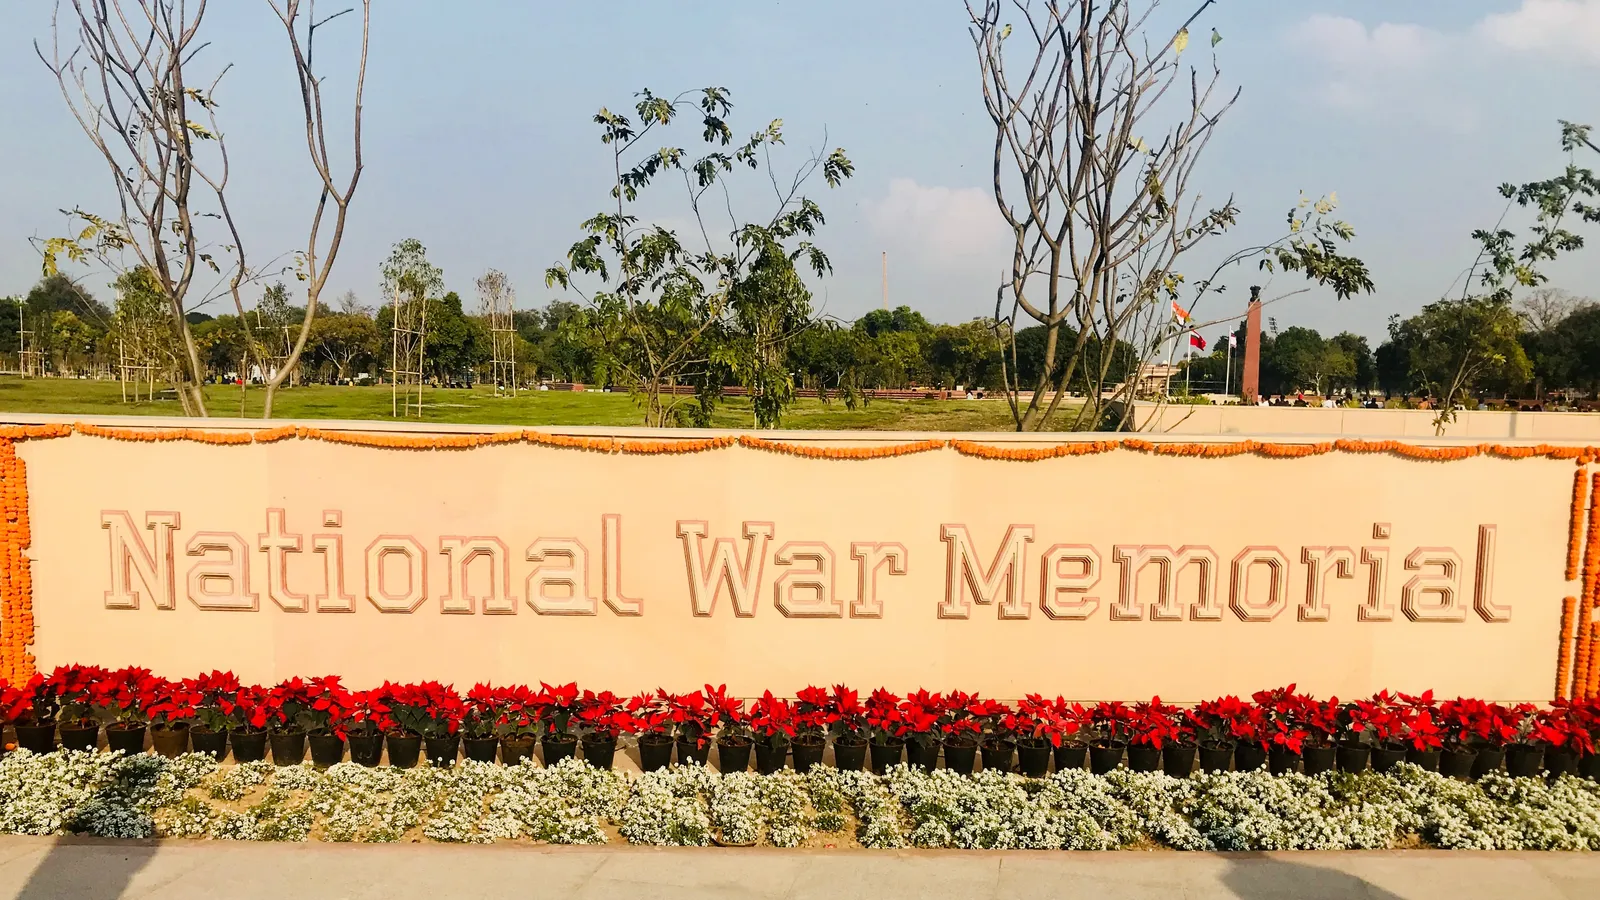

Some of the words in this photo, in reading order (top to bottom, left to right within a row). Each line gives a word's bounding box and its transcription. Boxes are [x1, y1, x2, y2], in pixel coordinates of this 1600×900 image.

[101, 507, 644, 617] National
[676, 520, 908, 619] War
[937, 522, 1512, 623] Memorial
